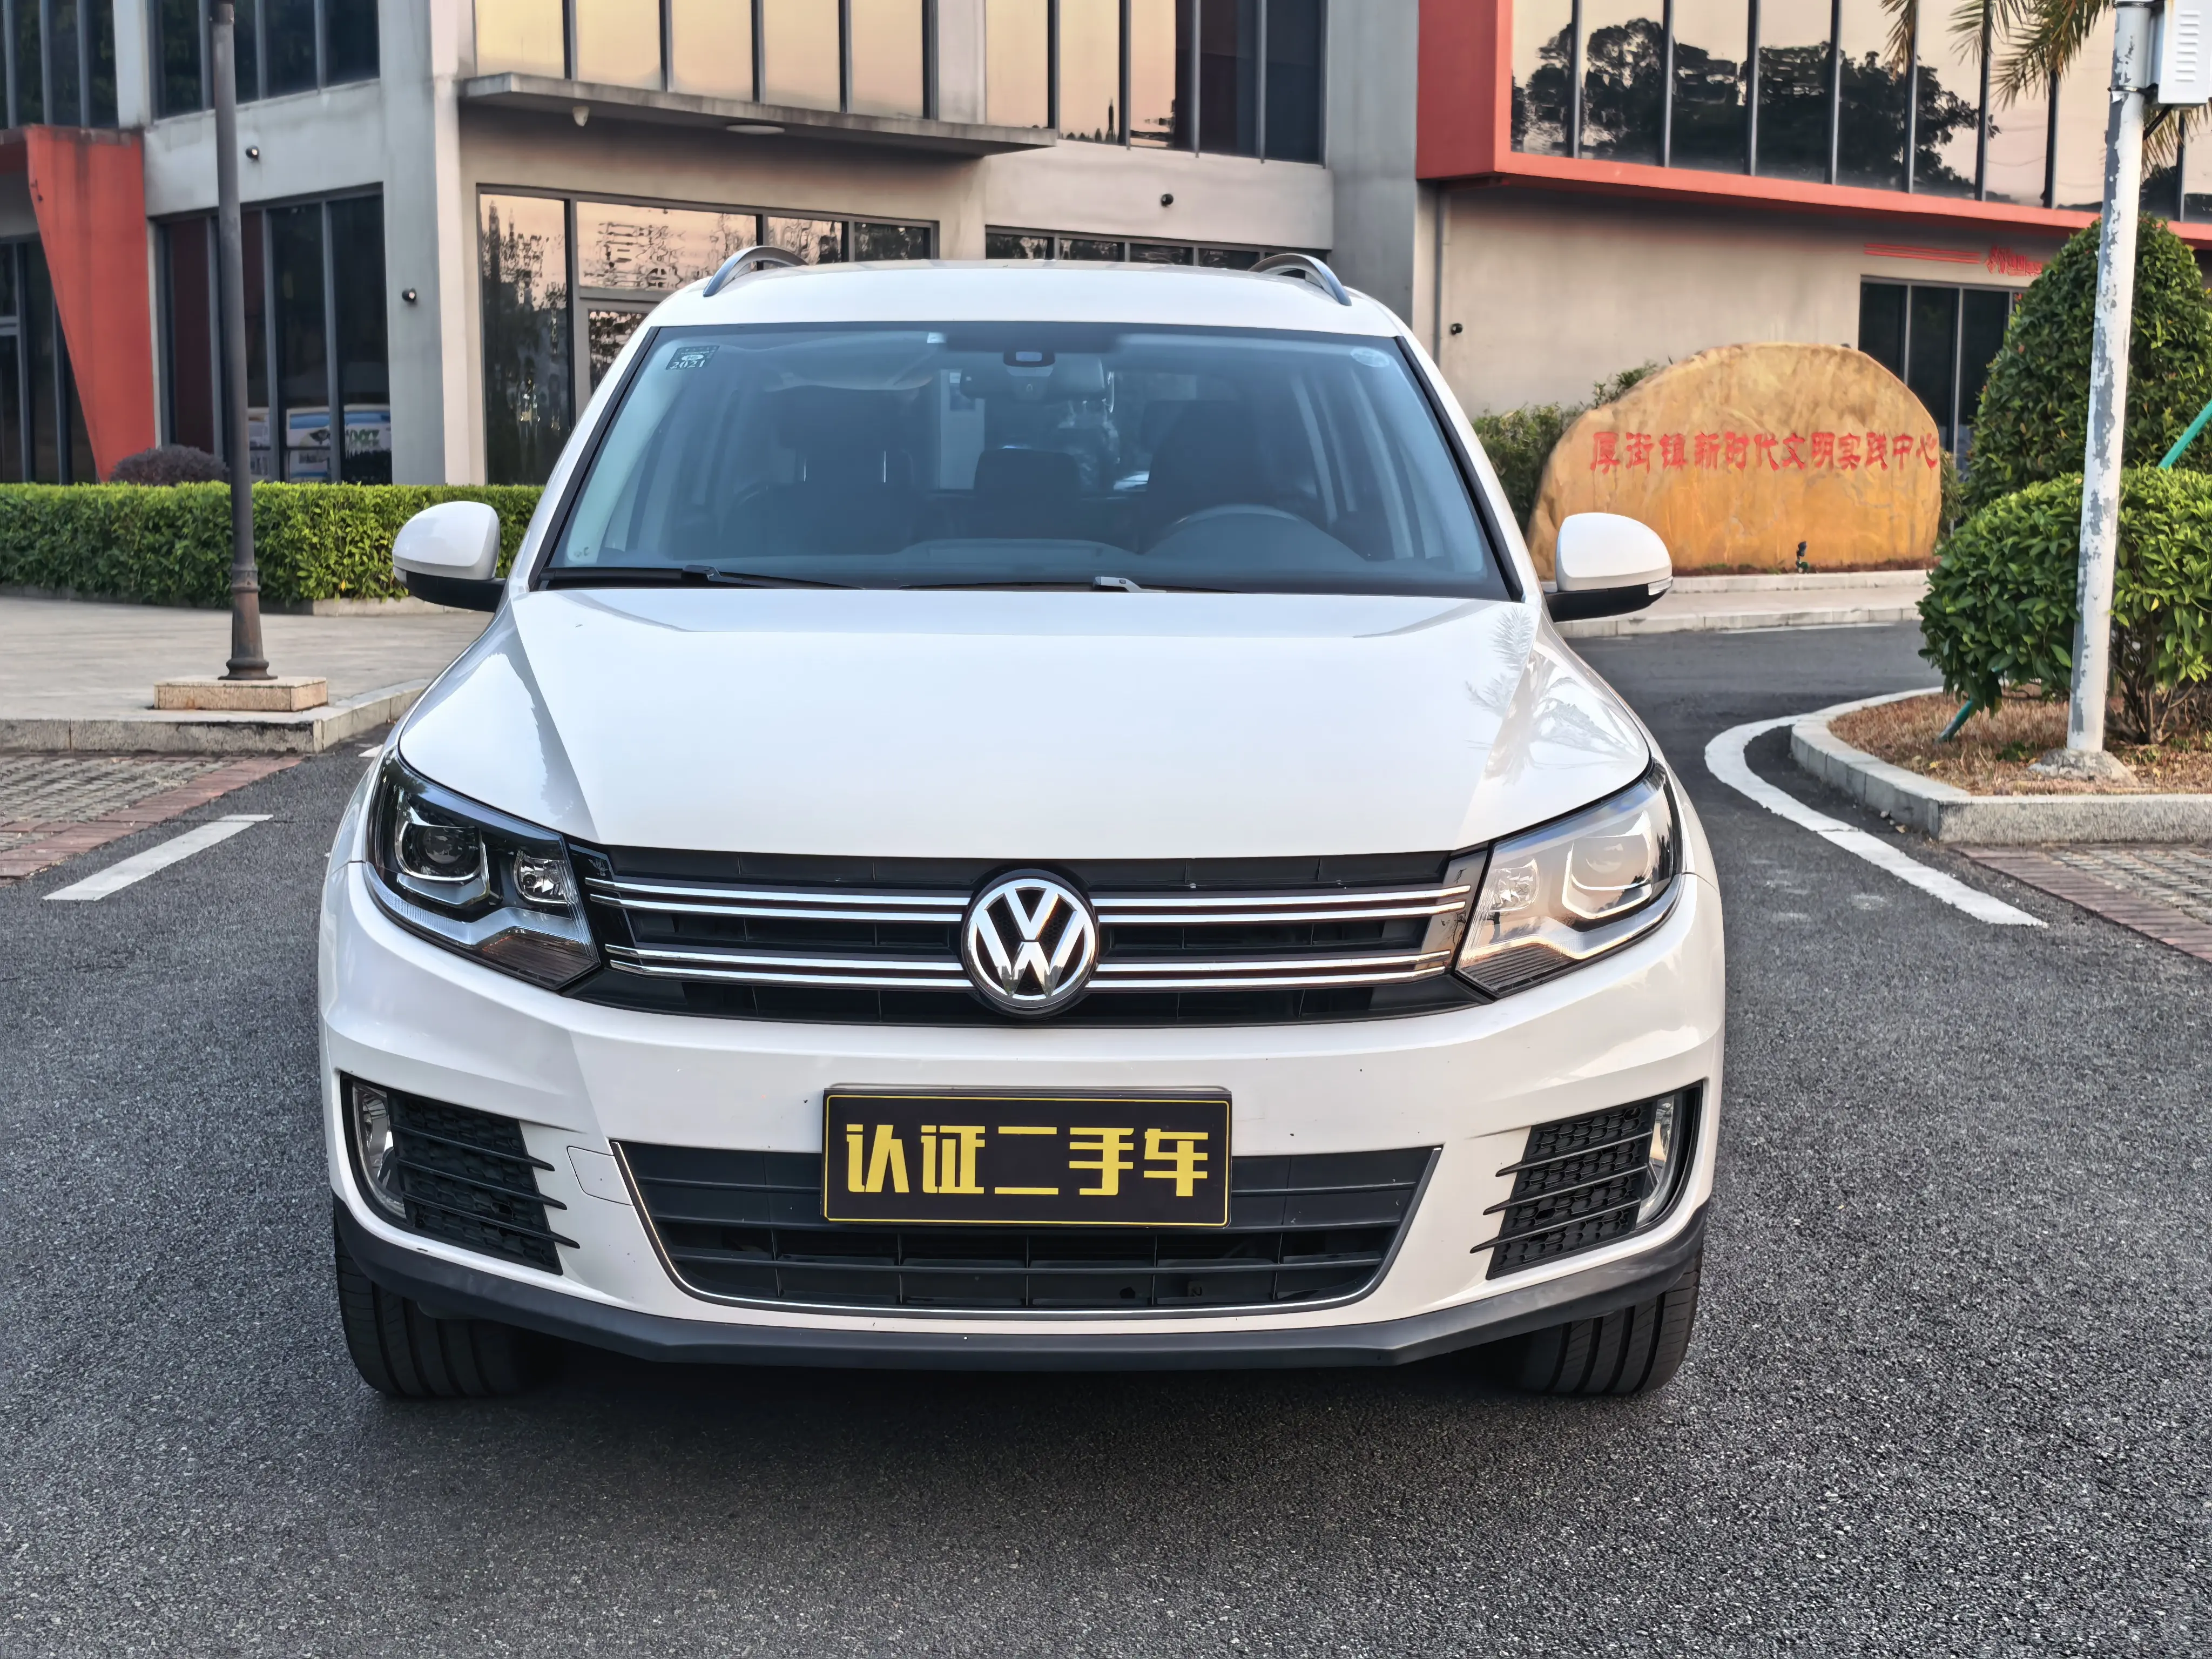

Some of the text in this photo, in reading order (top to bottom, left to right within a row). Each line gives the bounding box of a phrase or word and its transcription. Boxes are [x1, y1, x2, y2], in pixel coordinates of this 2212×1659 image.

[670, 360, 705, 369] 2021
[1590, 431, 1938, 472] 厚街镇新时代文明实践中心
[846, 1124, 1209, 1197] 认证二手车
